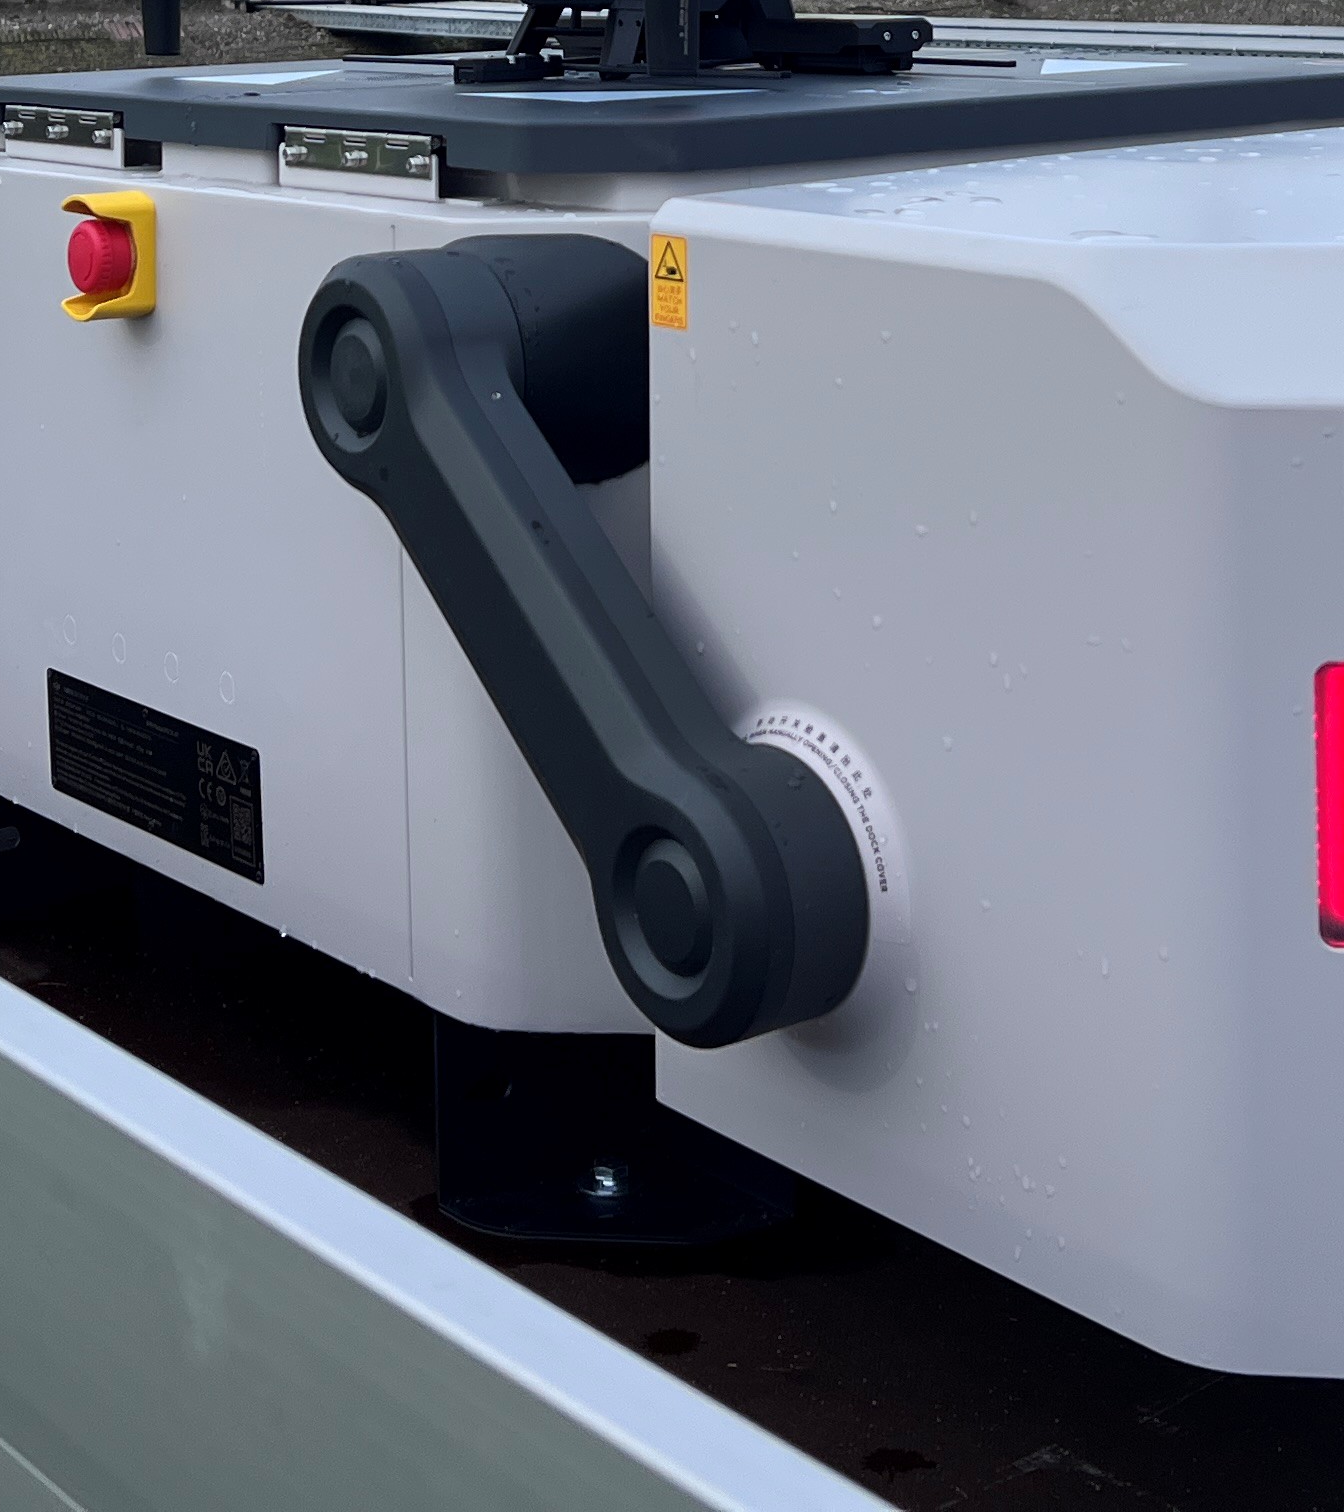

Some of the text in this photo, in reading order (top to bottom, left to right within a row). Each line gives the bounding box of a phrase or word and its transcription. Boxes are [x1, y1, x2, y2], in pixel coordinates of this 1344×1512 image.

[857, 804, 870, 824] THE
[865, 825, 880, 854] DOCK
[875, 856, 888, 892] COVER
